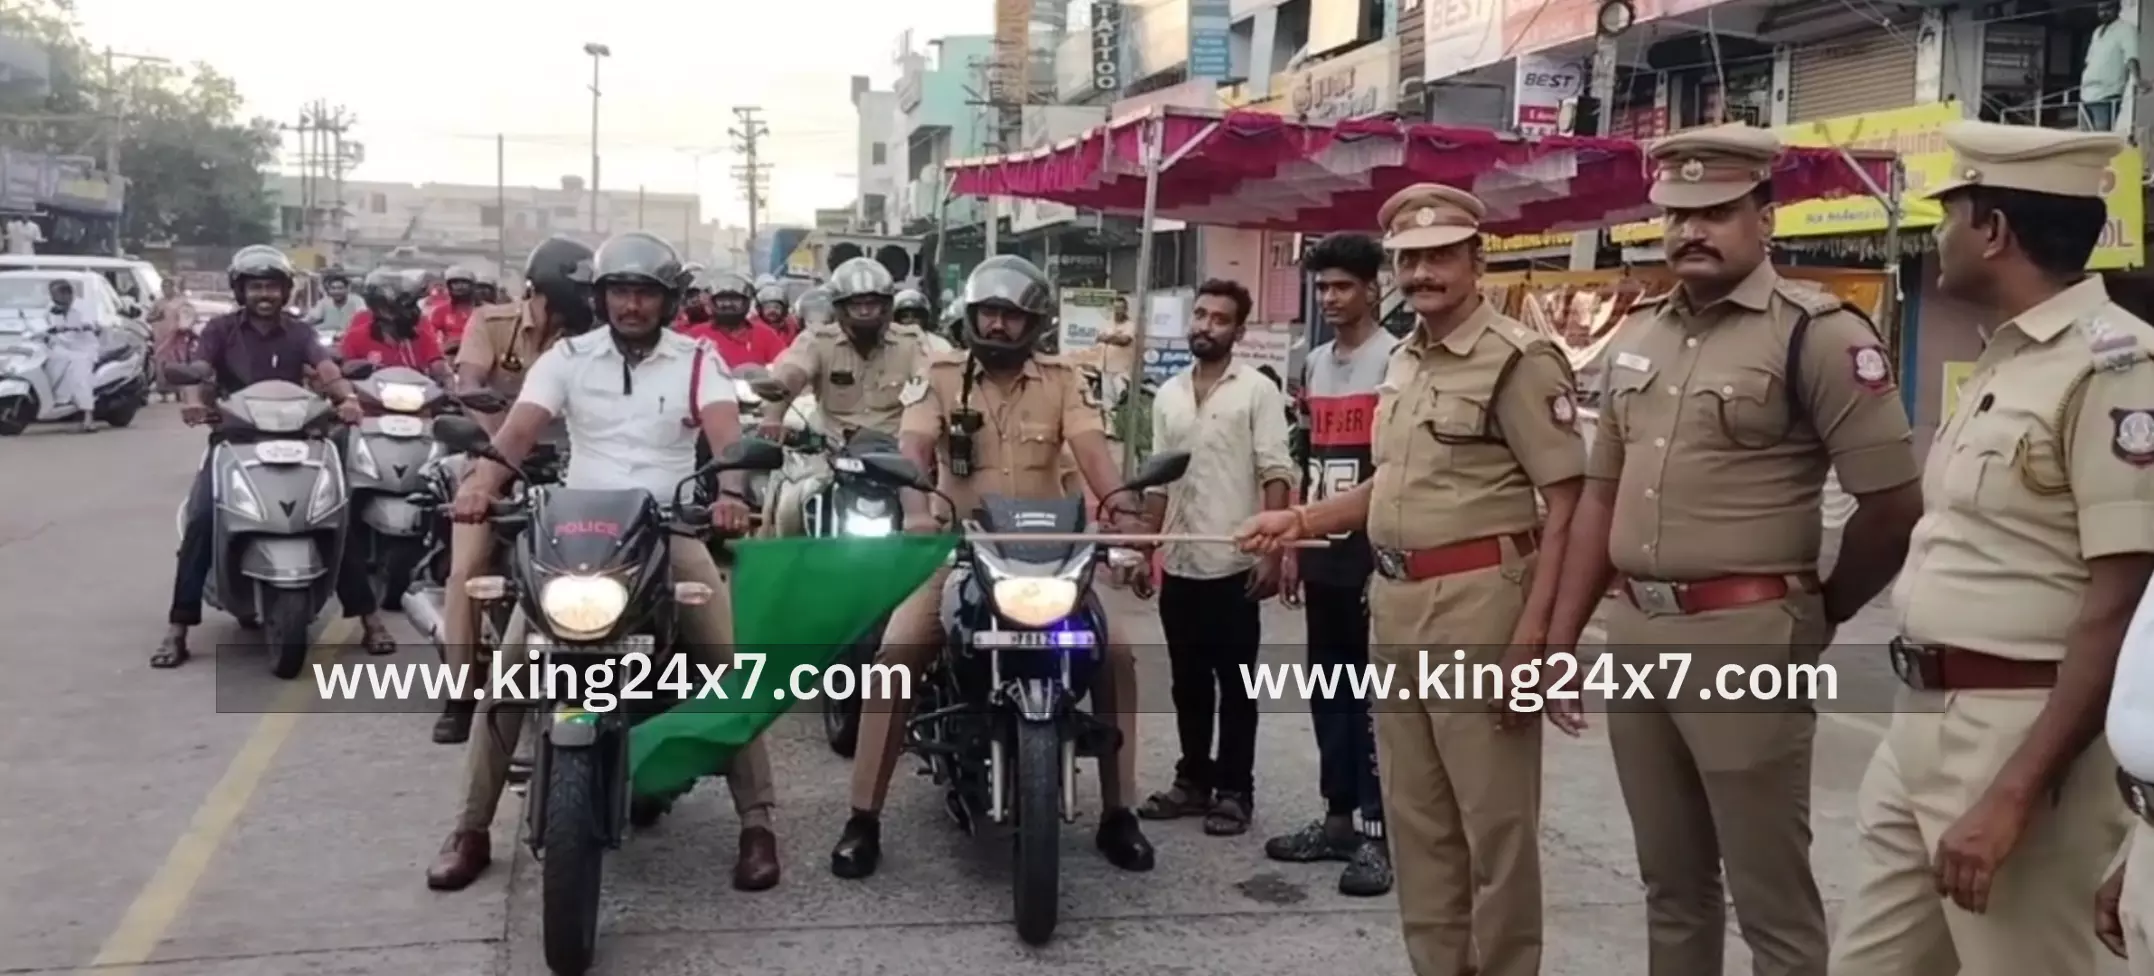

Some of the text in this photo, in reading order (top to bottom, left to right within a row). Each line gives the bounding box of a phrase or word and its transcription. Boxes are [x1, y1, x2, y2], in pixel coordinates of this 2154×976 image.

[1095, 4, 1116, 89] TATTOO
[1523, 72, 1576, 89] BEST
[555, 519, 621, 538] POLICE
